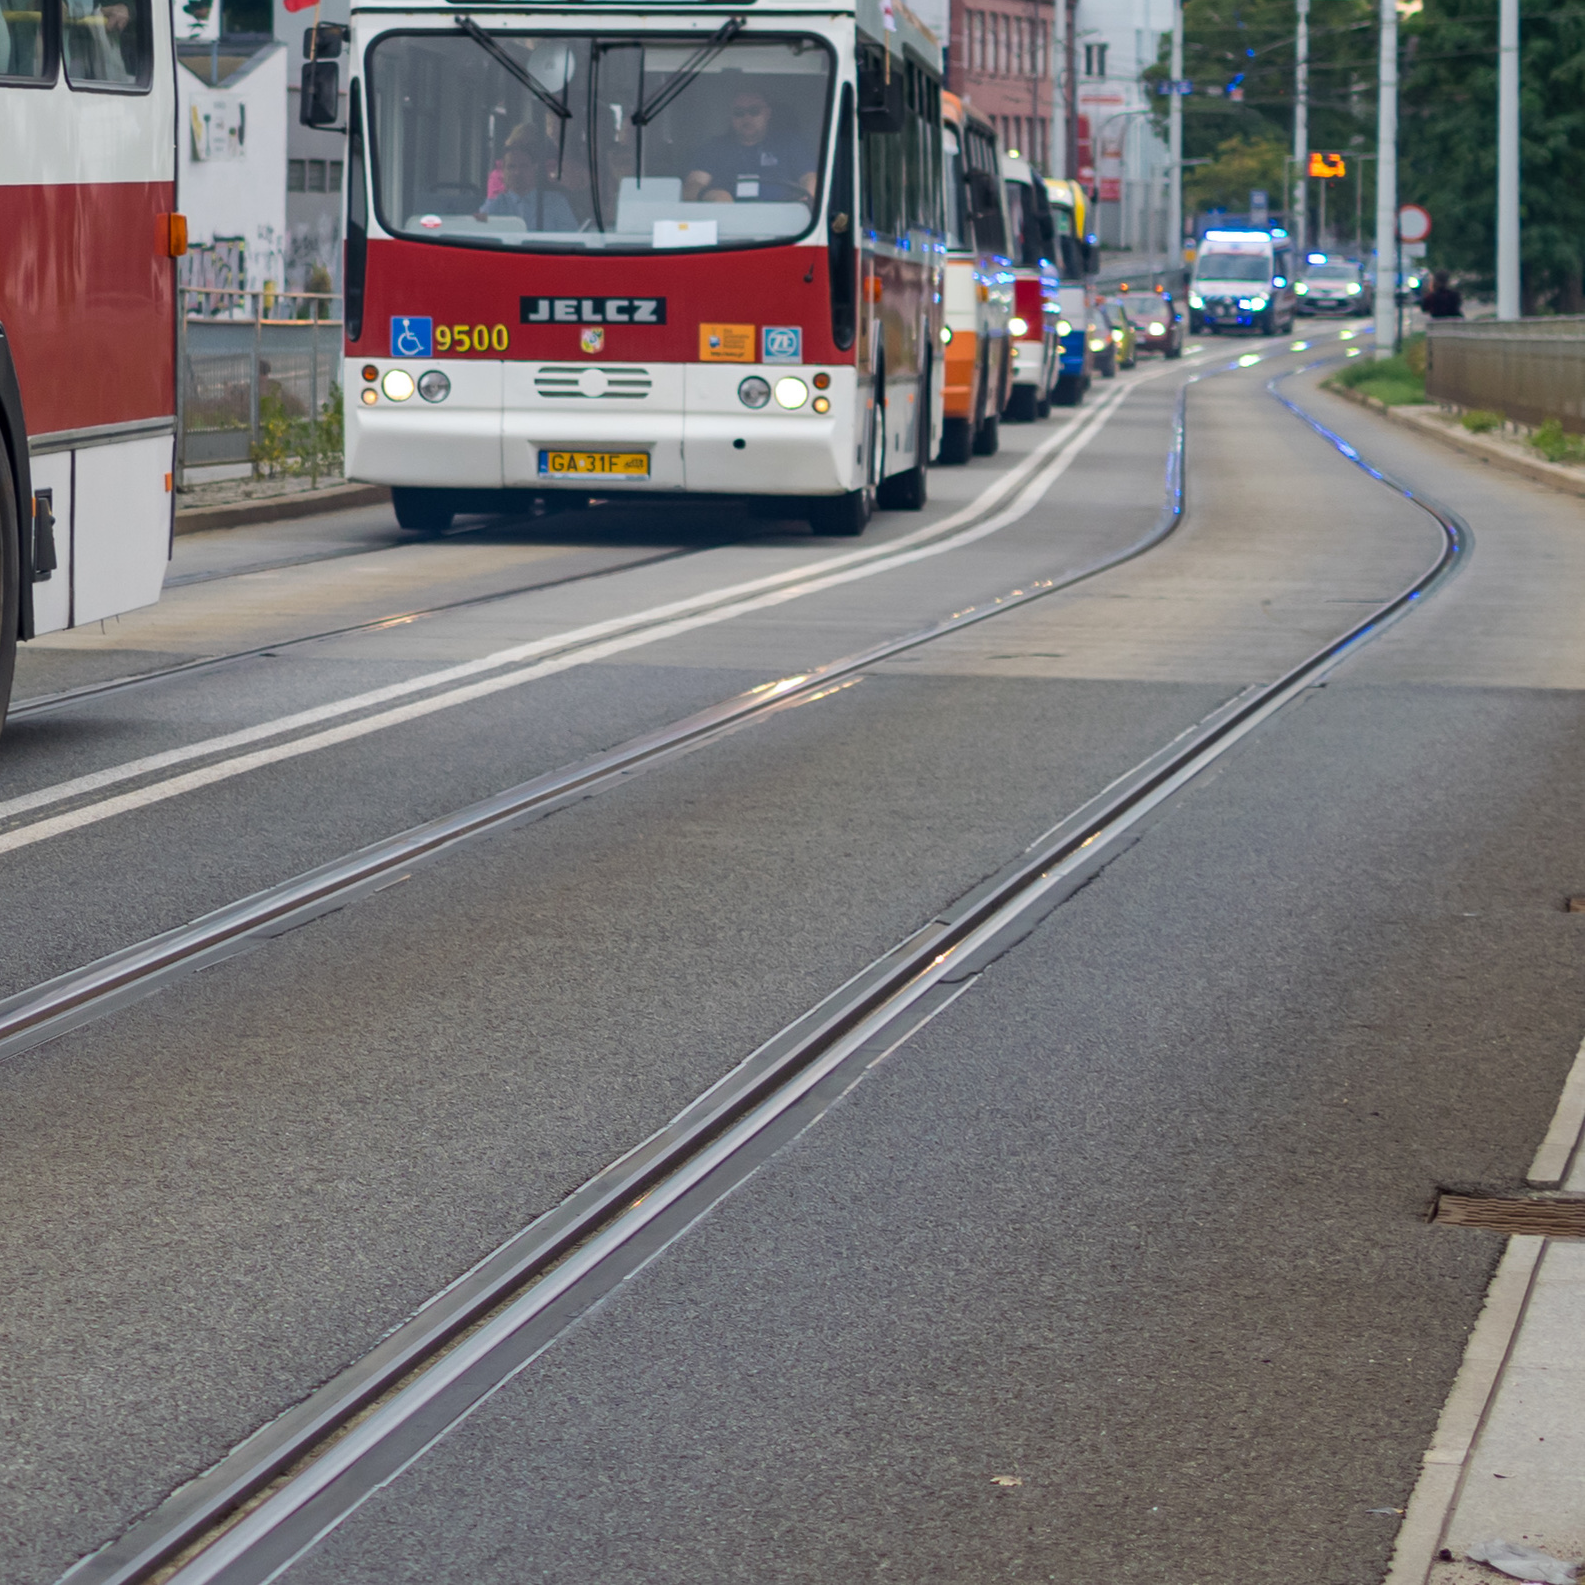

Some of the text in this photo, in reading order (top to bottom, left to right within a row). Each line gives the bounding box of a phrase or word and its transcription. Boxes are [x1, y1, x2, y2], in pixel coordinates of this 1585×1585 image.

[528, 298, 658, 323] JELCZ
[434, 323, 510, 353] 9500
[772, 333, 792, 351] ZF
[551, 453, 621, 473] GA 31F
